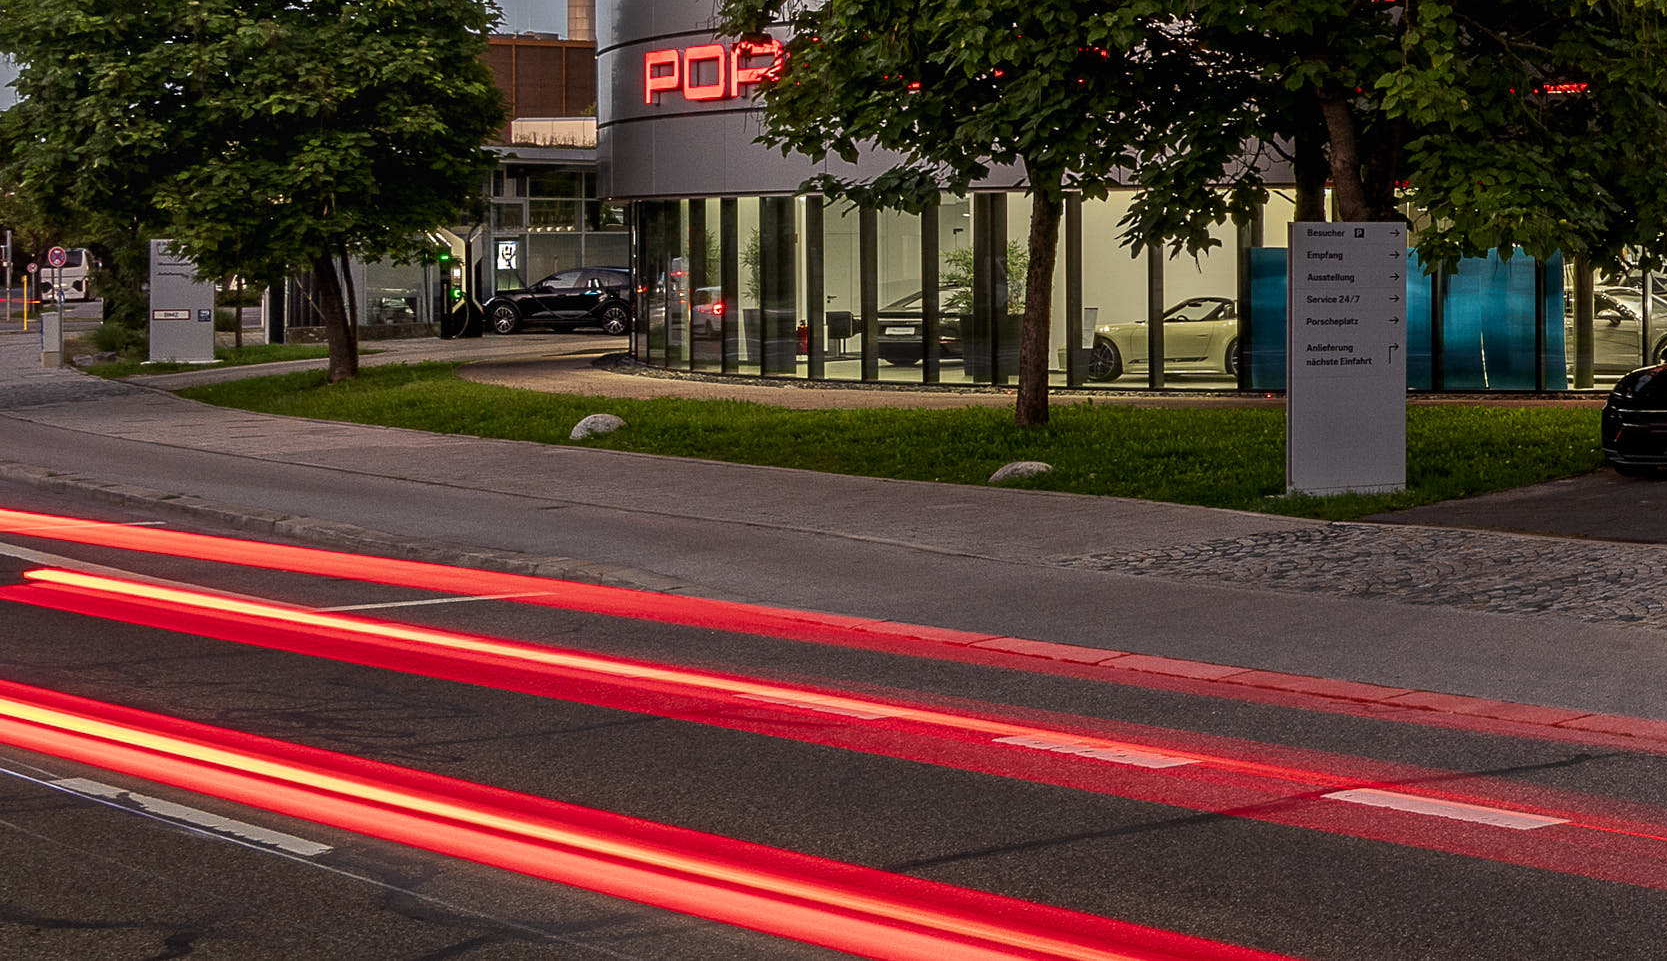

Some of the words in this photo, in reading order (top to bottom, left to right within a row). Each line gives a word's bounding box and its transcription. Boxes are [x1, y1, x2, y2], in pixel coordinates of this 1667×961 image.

[1307, 228, 1345, 237] Besucher
[1307, 250, 1343, 261] Empfang
[1307, 273, 1355, 283] Ausstellung
[1306, 295, 1338, 303] Service
[1339, 295, 1360, 303] 24/7
[1306, 317, 1359, 327] Porscheplatz
[1306, 343, 1353, 353] Anlieferung
[1306, 357, 1339, 366] nächste
[1340, 357, 1372, 366] Einfahrt
